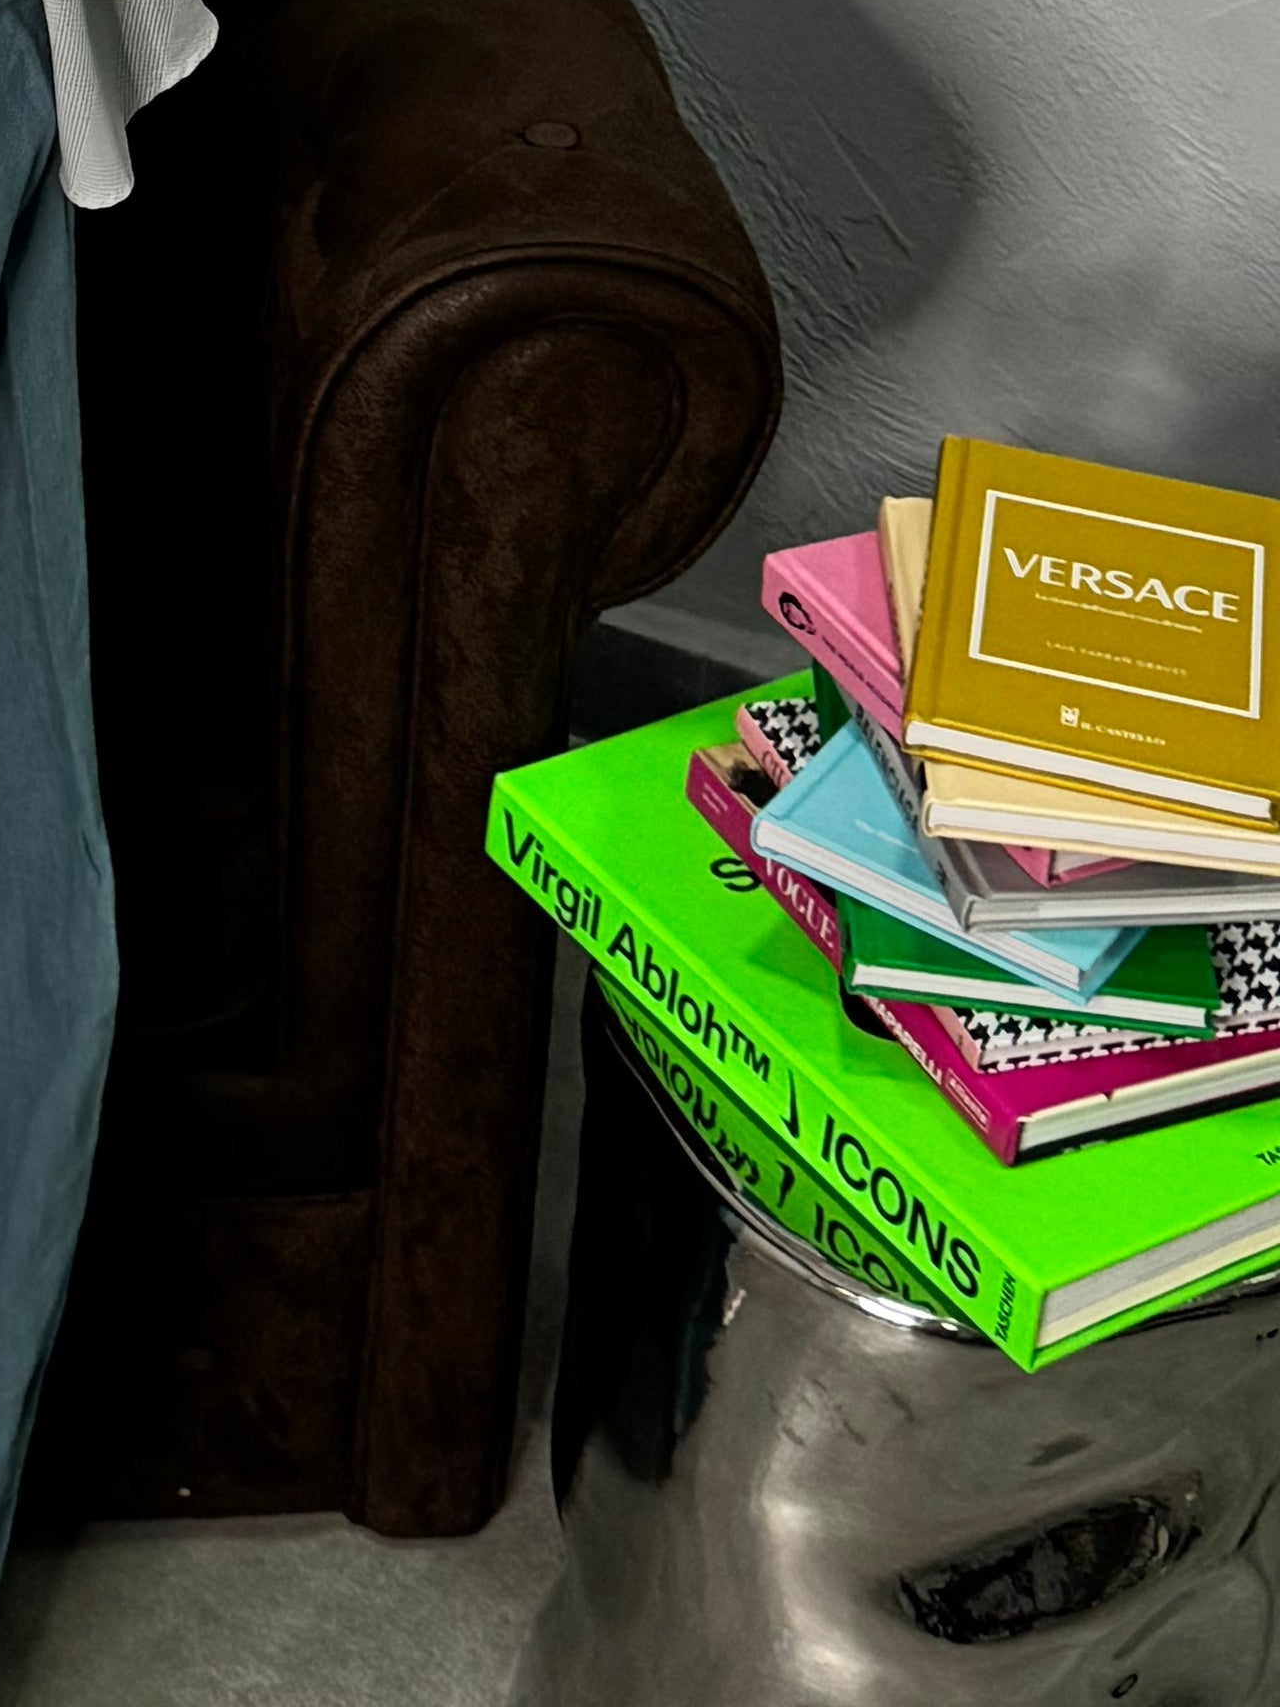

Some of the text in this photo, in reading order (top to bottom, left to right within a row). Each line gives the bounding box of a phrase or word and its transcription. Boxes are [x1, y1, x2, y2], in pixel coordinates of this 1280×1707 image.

[1002, 547, 1241, 623] VERSACE
[502, 808, 602, 941] Virgil
[821, 1114, 983, 1300] ICONS
[993, 1270, 1017, 1345] TASCHEN
